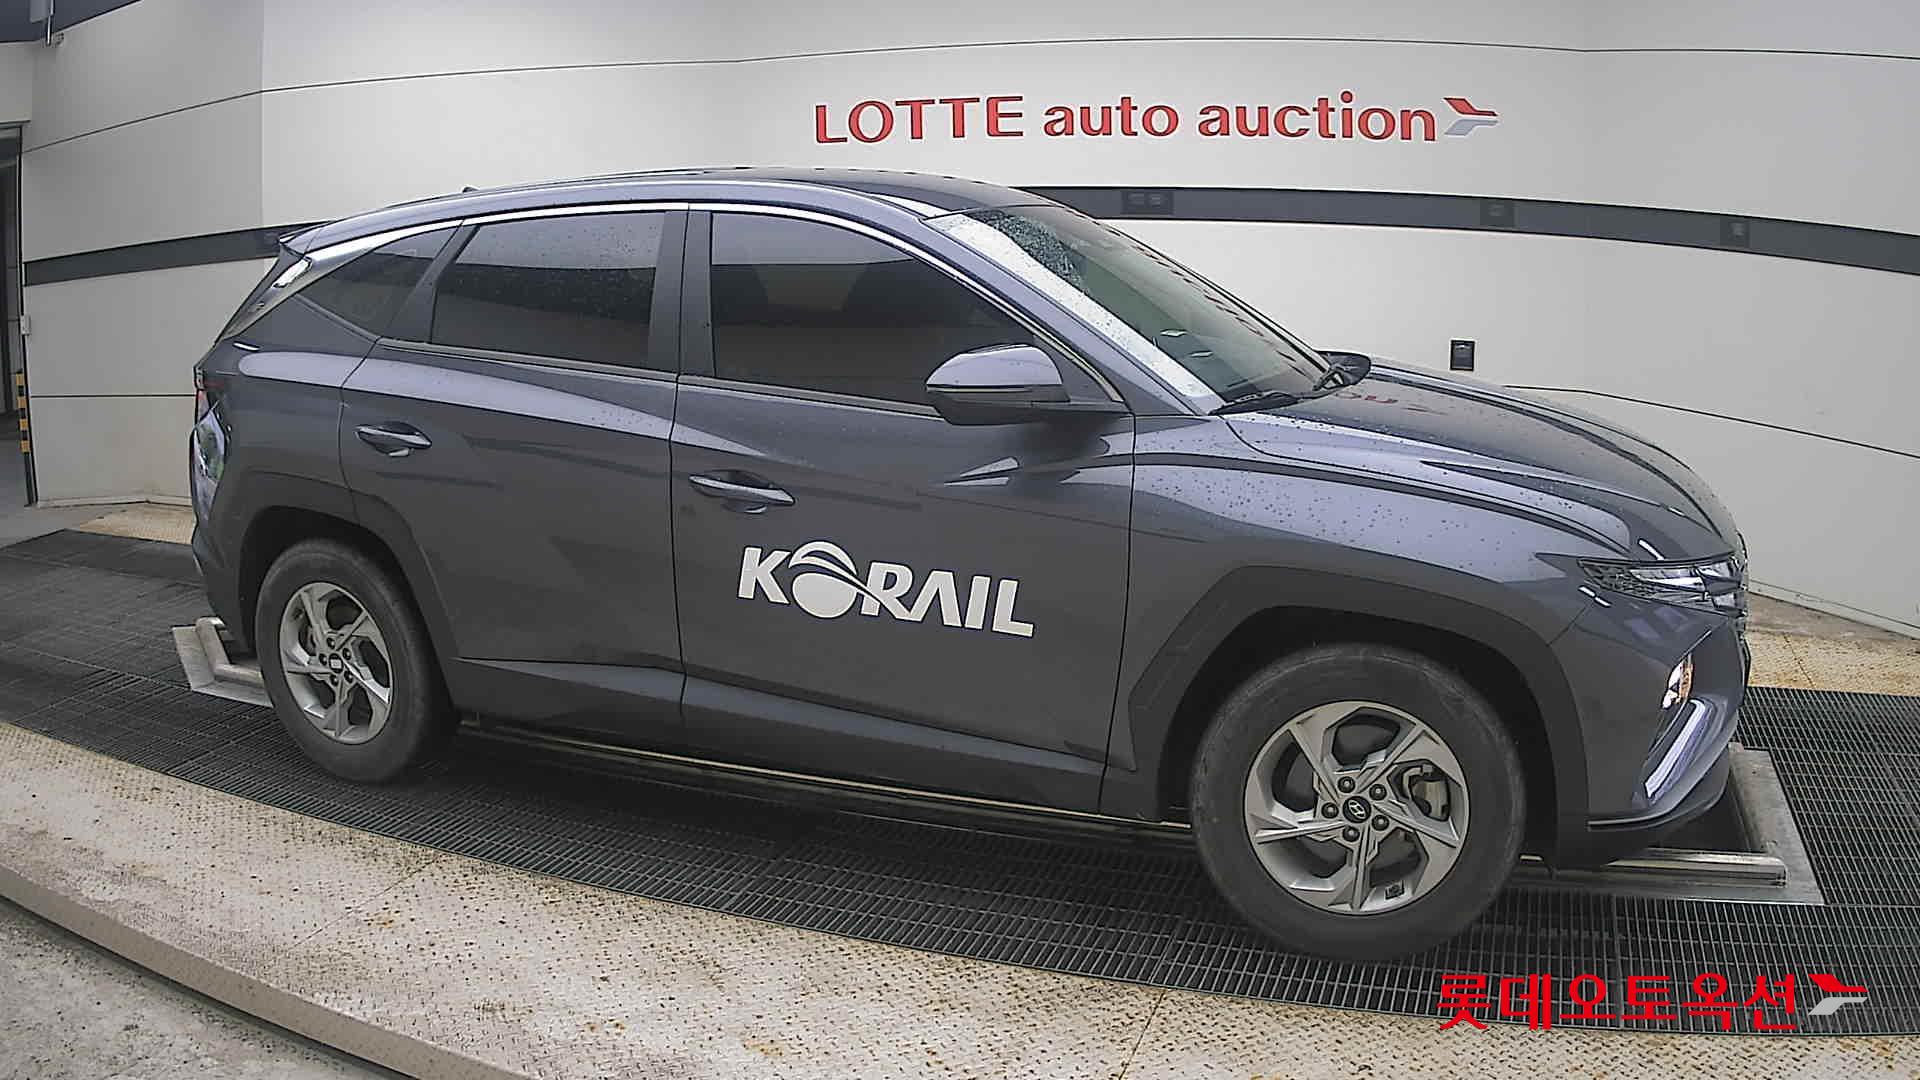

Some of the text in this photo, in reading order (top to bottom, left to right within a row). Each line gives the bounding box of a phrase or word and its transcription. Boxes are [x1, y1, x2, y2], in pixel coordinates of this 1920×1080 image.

[815, 91, 1437, 143] LOTTE auto auction
[737, 540, 1036, 639] KORAIL
